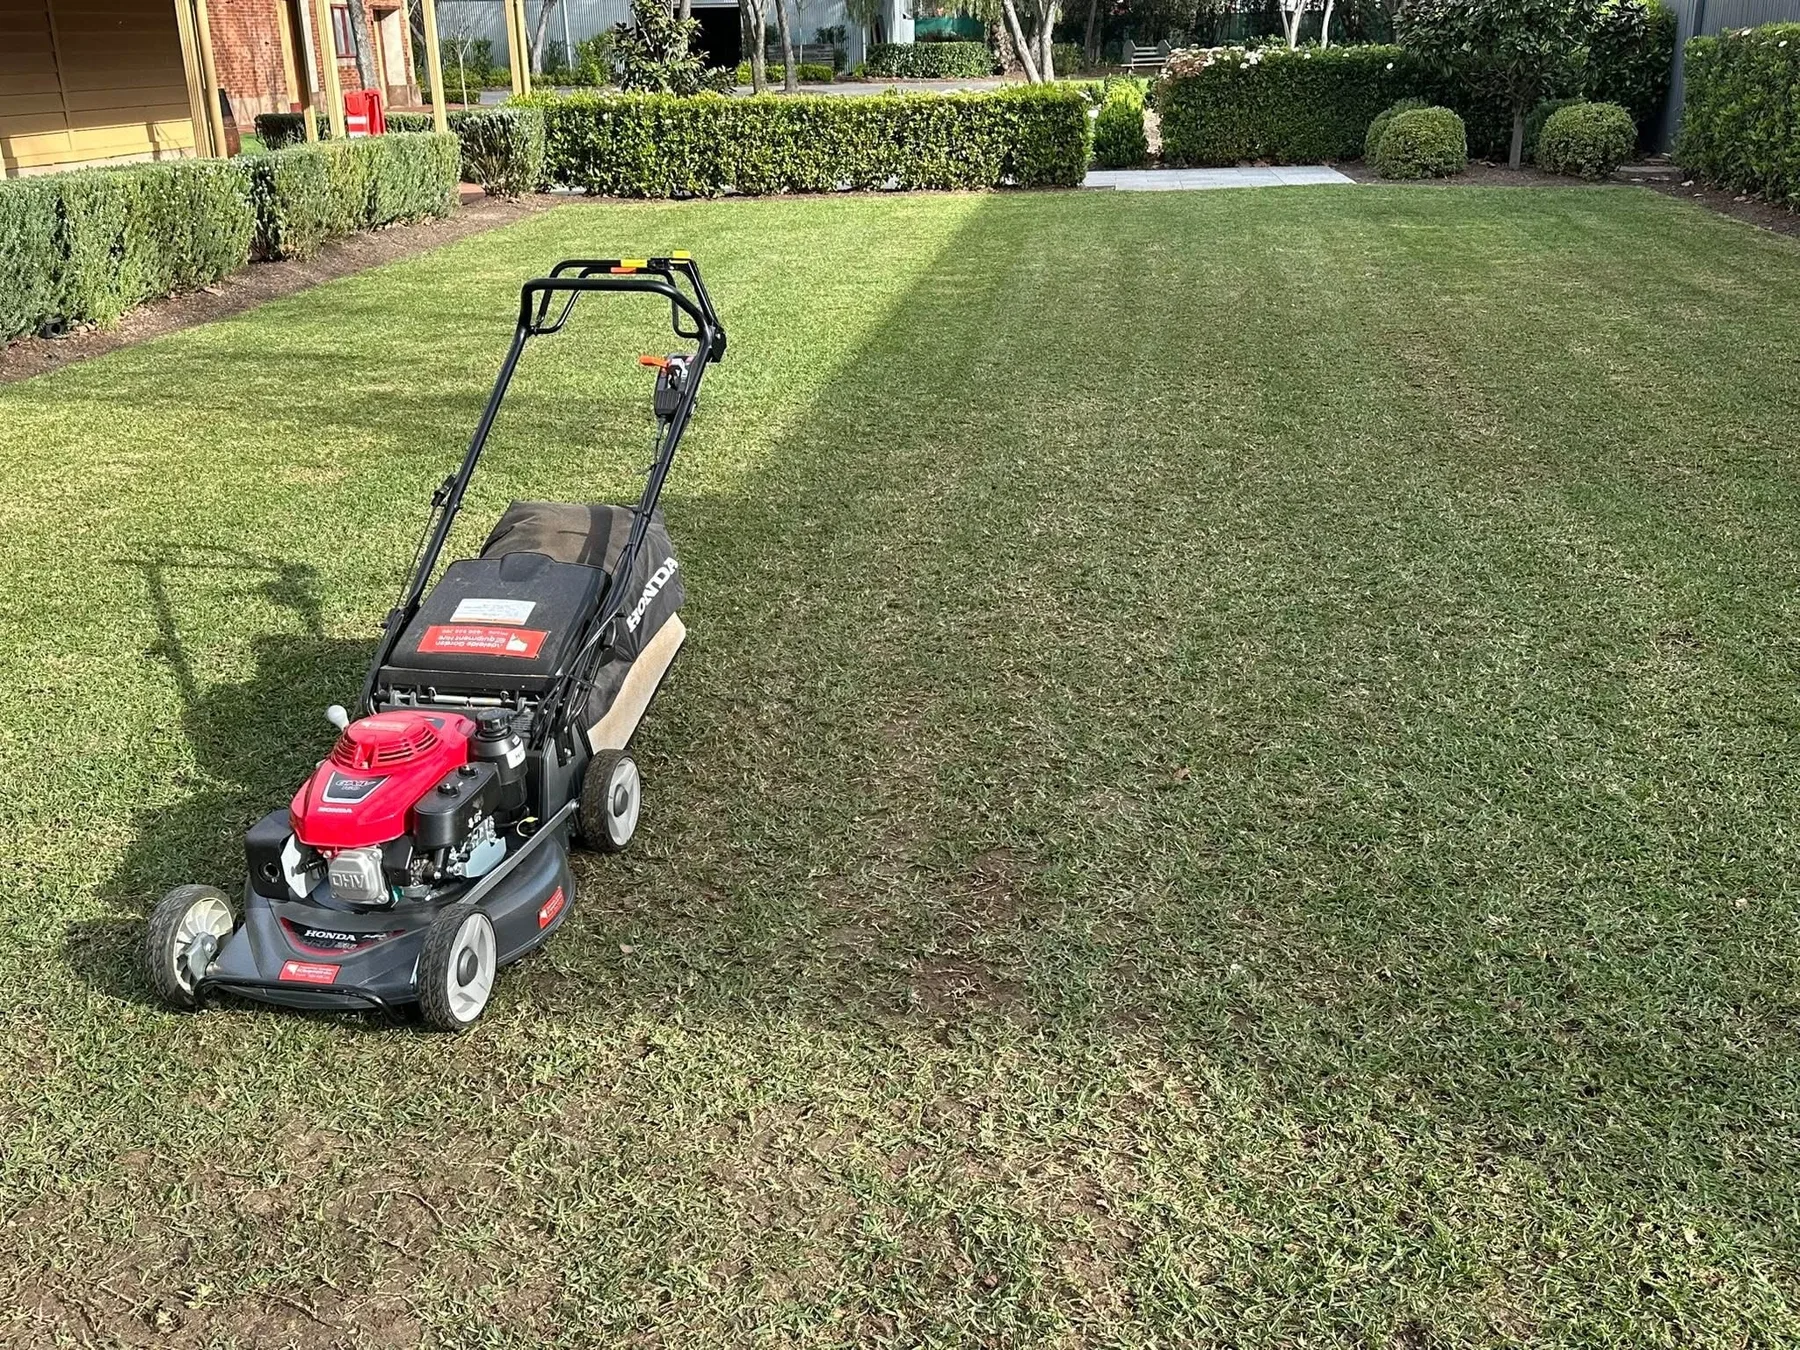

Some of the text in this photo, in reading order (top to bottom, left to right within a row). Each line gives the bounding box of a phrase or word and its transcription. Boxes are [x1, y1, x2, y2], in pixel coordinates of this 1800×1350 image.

[626, 556, 679, 633] HONDA
[317, 806, 353, 814] HONDA
[331, 873, 365, 889] OHV
[303, 929, 357, 942] HONDA
